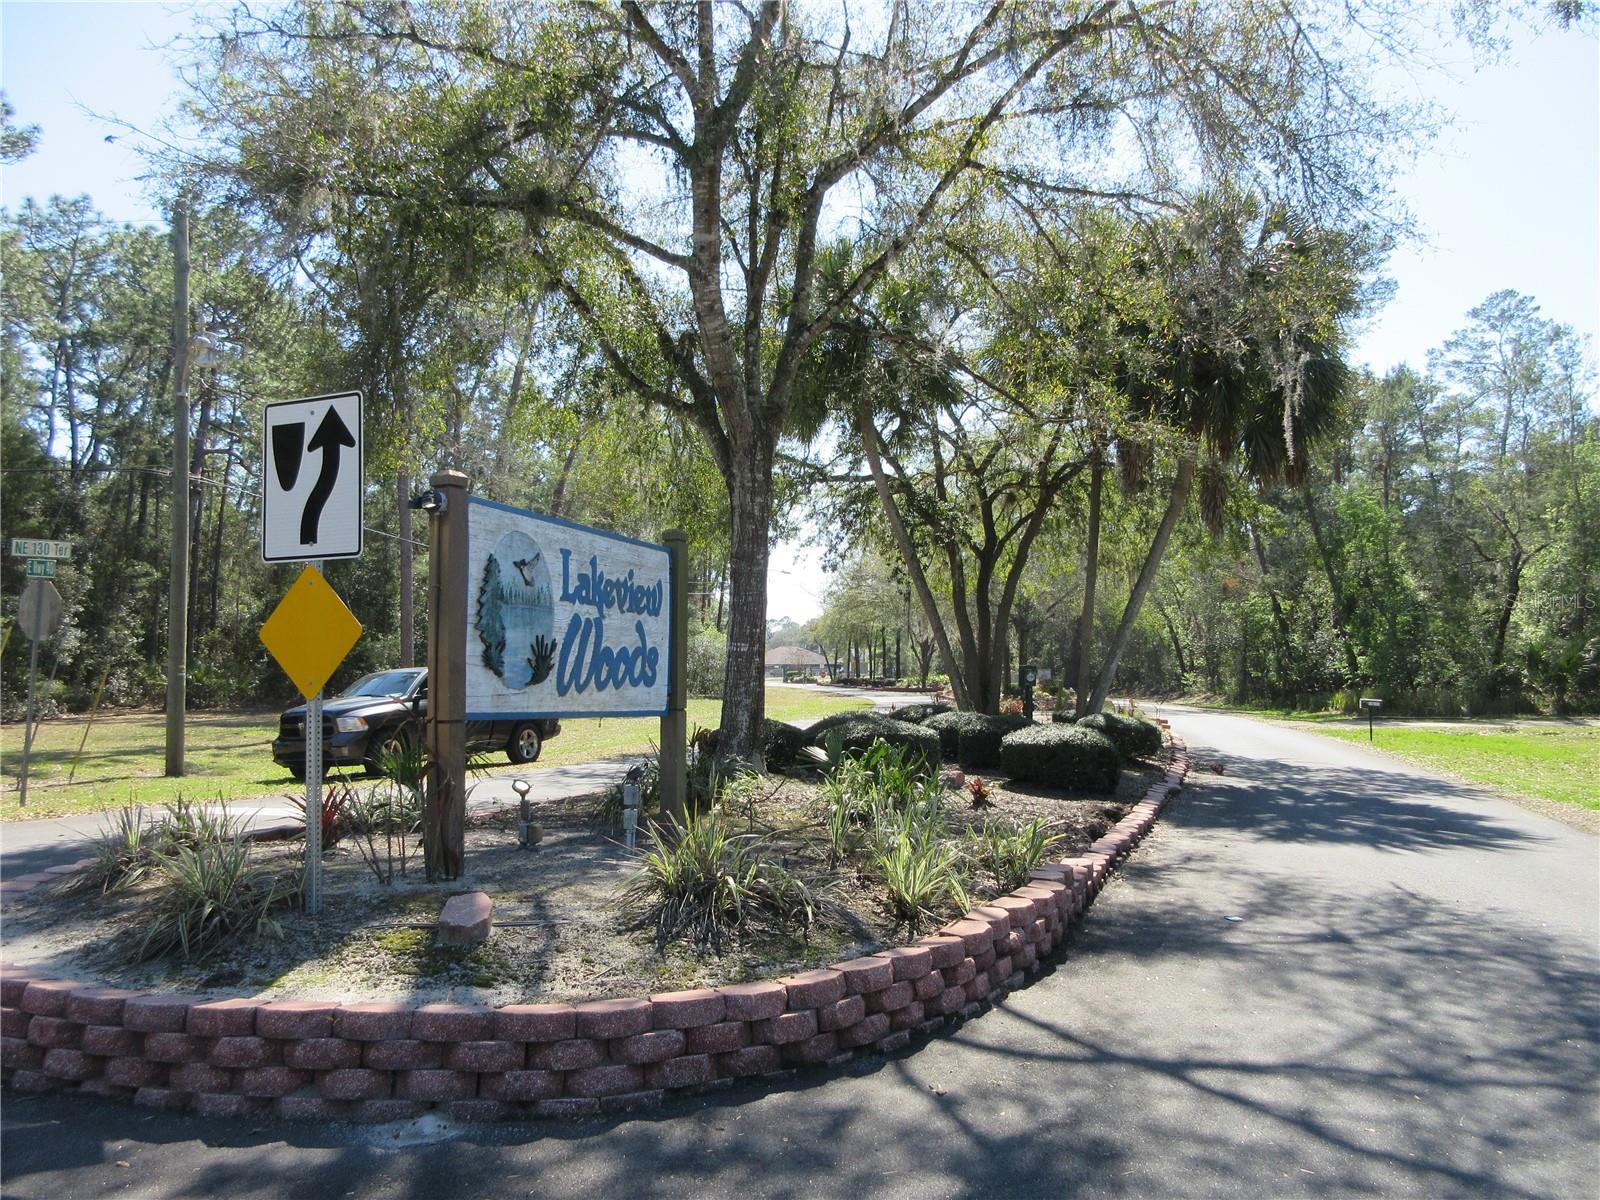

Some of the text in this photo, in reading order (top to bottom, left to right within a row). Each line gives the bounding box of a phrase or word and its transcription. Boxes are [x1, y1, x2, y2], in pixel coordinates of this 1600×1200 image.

[15, 541, 67, 556] NE 130 Ter
[559, 548, 663, 618] Lakeview
[556, 613, 659, 697] Woods
